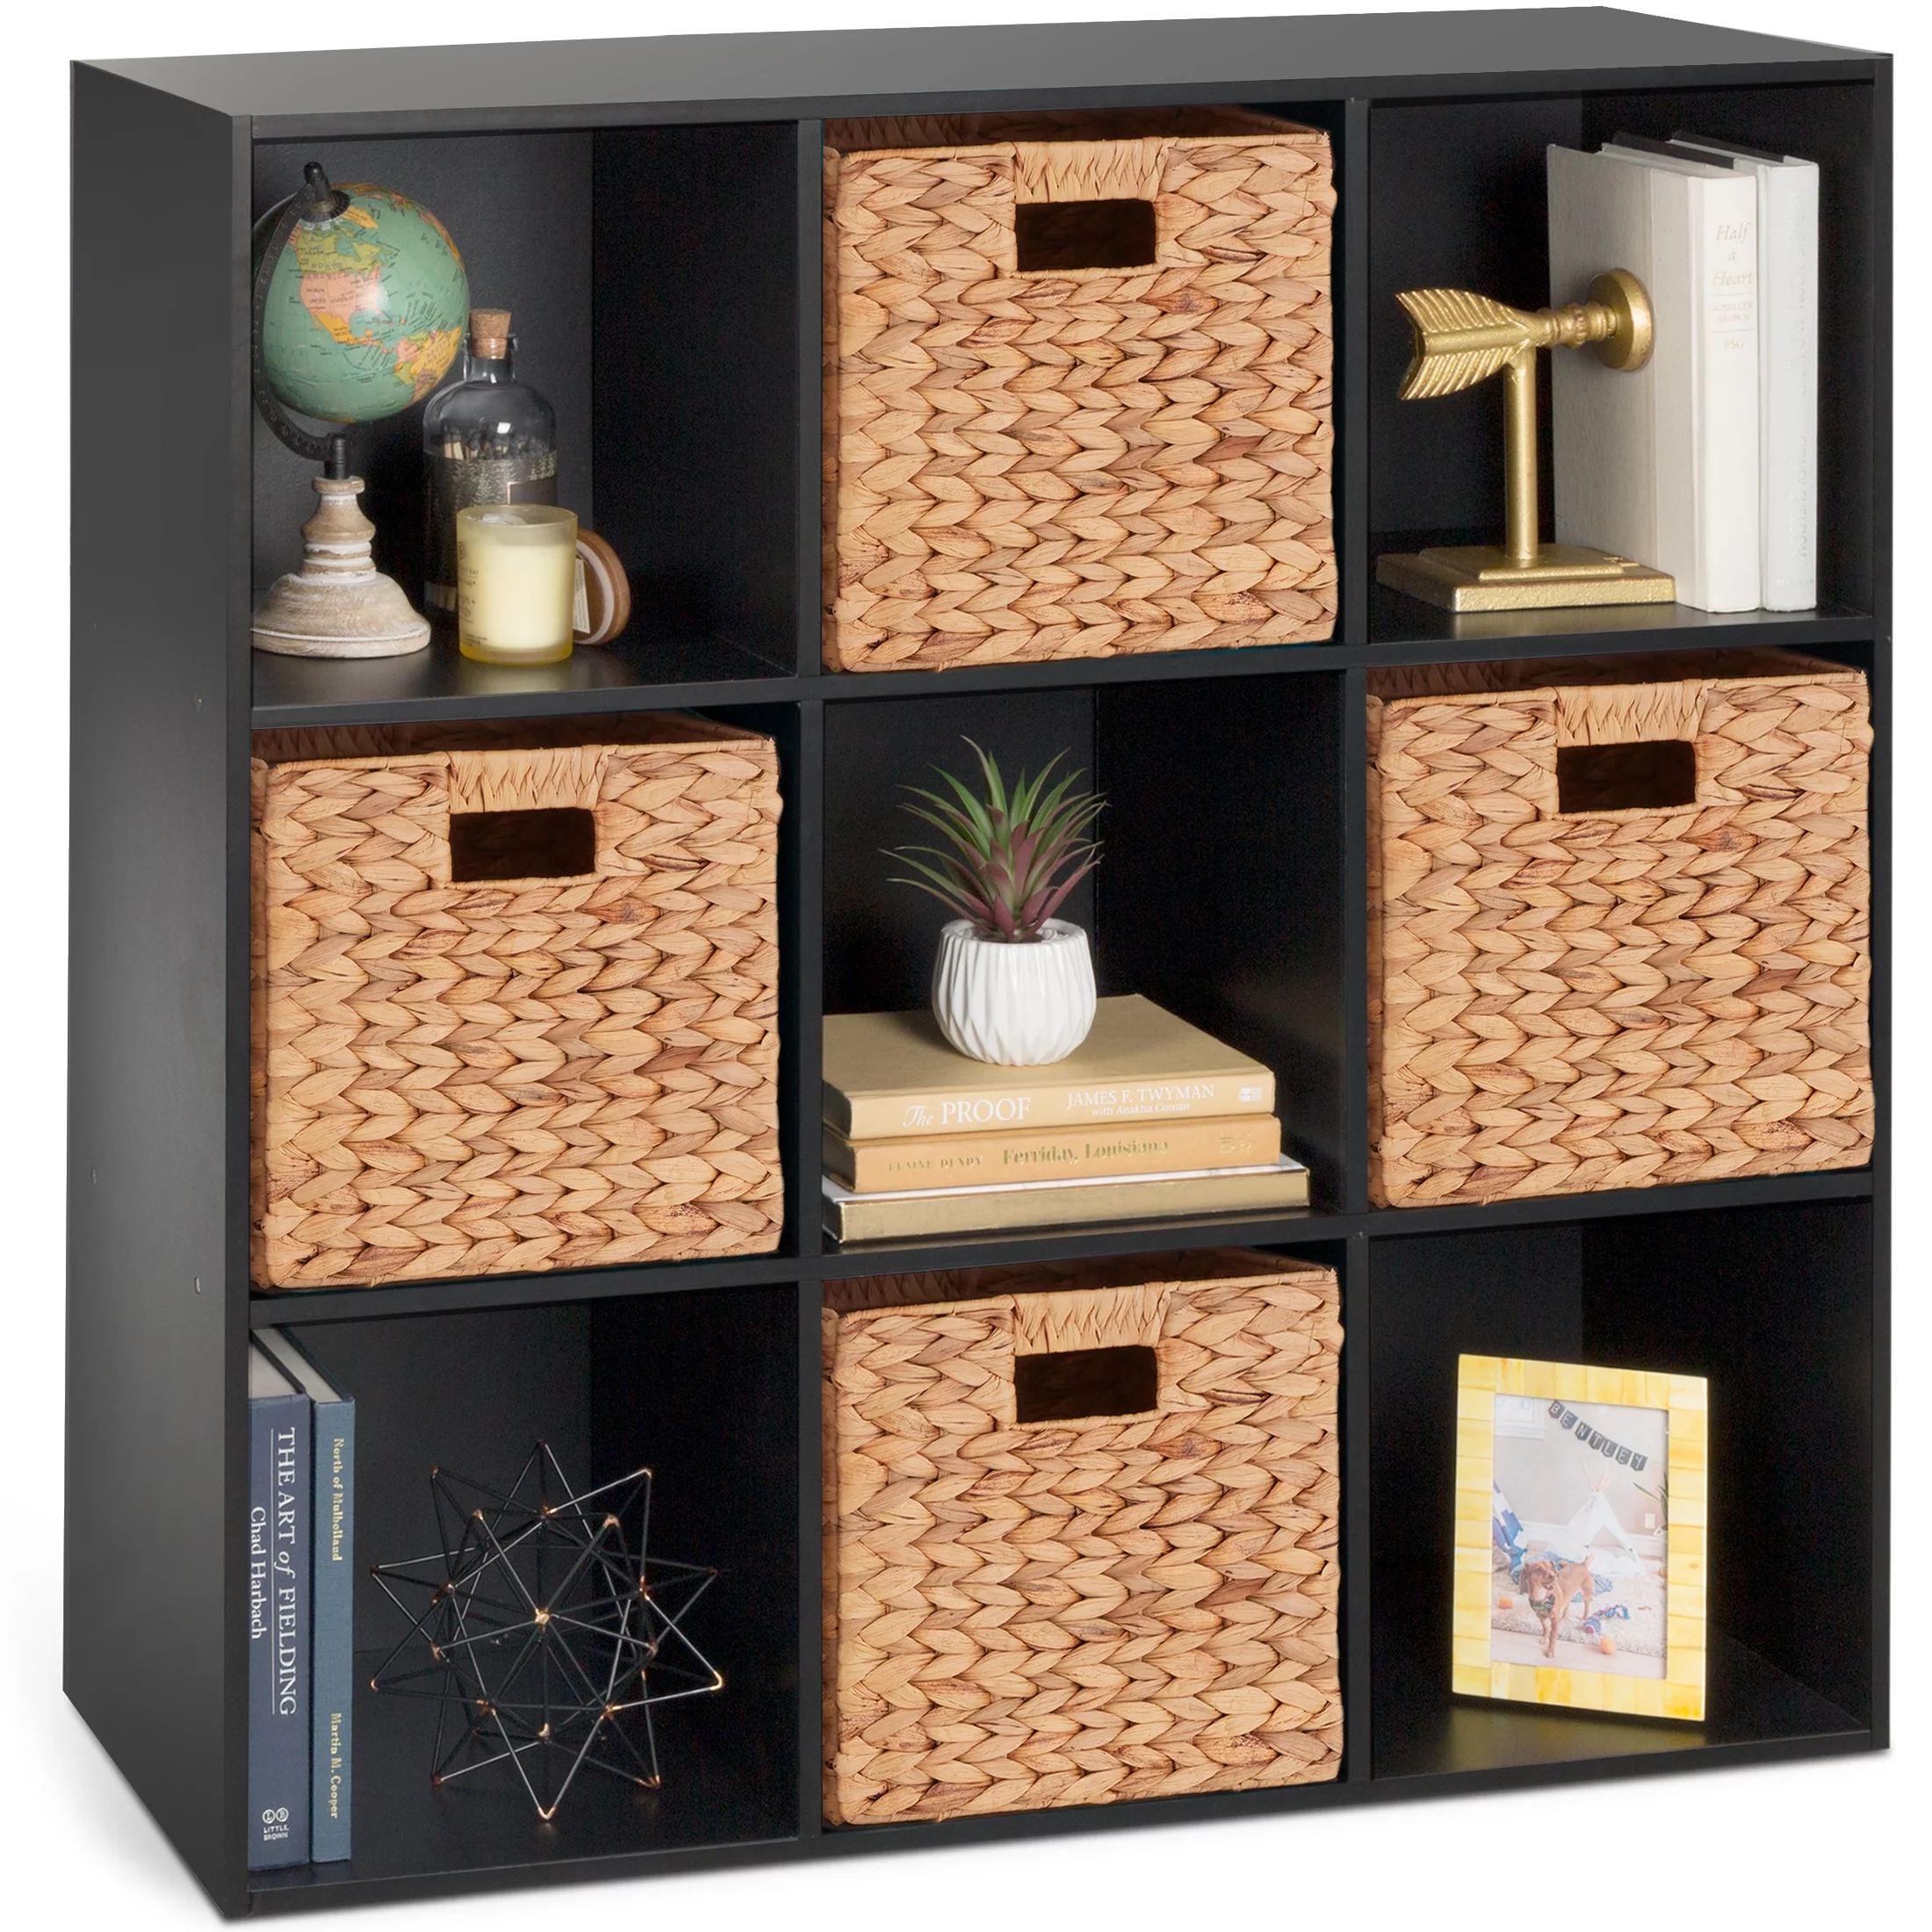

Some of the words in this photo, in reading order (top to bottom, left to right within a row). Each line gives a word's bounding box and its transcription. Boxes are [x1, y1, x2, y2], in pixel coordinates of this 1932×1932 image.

[1715, 222, 1750, 244] Half
[1727, 251, 1736, 262] a
[1712, 270, 1753, 286] Heart
[1724, 339, 1744, 350] FSG
[1066, 1091, 1117, 1109] JAMES
[1121, 1089, 1133, 1104] F.
[1136, 1084, 1215, 1103] TWYMAN
[1092, 1107, 1114, 1117] with
[1116, 1104, 1153, 1116] Anakha
[903, 1105, 934, 1128] The
[941, 1097, 1031, 1125] PROOF
[1003, 1145, 1079, 1165] Ferriday,
[1085, 1140, 1169, 1160] Louisiana
[1550, 1403, 1644, 1470] BENTLEY
[278, 1426, 296, 1486] THE
[332, 1438, 344, 1474] North
[332, 1476, 343, 1489] of
[250, 1506, 267, 1555] Chad
[278, 1490, 296, 1545] ART
[332, 1492, 343, 1561] Mulholland
[273, 1551, 296, 1579] of
[250, 1561, 268, 1640] Harbach
[278, 1586, 297, 1716] FIELDING
[330, 1712, 342, 1755] Martin
[330, 1757, 342, 1773] M.
[328, 1775, 342, 1819] Cooper
